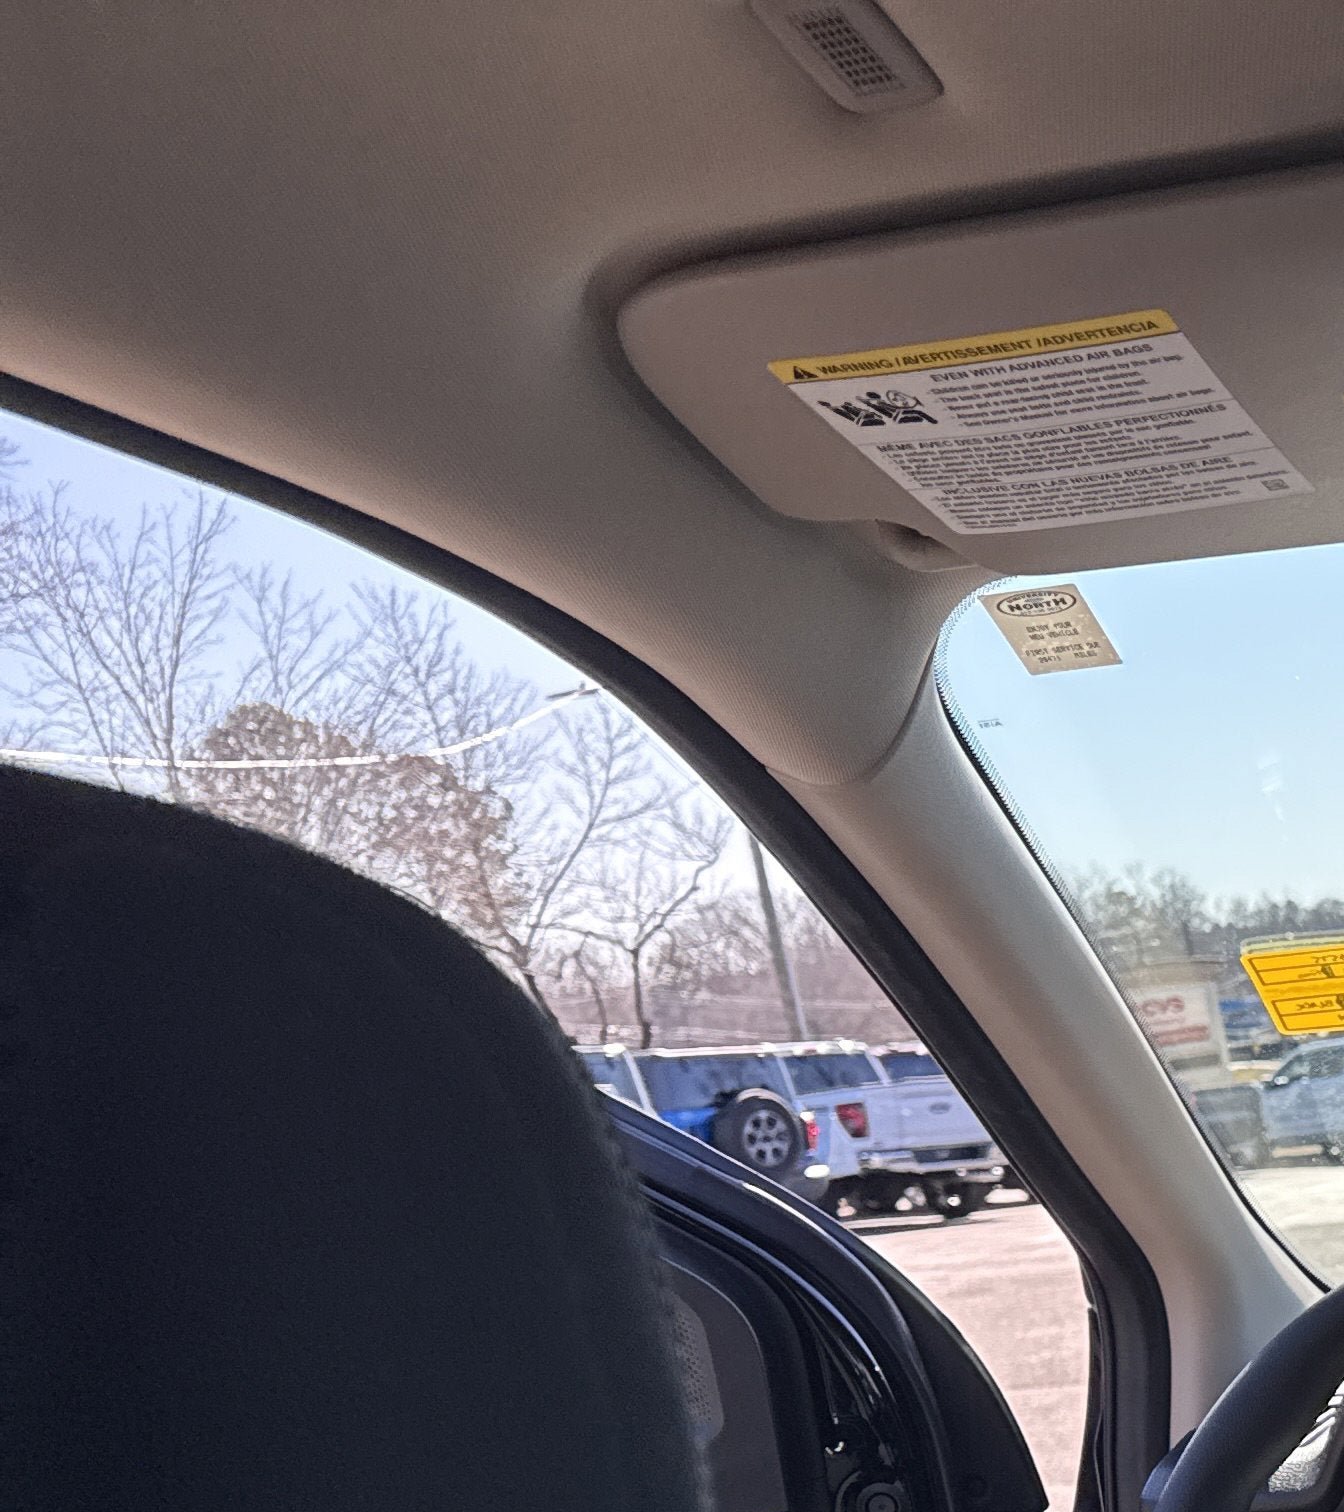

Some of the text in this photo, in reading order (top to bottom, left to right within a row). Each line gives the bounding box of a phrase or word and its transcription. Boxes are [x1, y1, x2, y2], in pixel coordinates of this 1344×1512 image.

[815, 357, 895, 376] WARNING
[928, 343, 1155, 382] EVEN WITH ADVANCED AIR BAGS
[1008, 597, 1067, 612] NORTH
